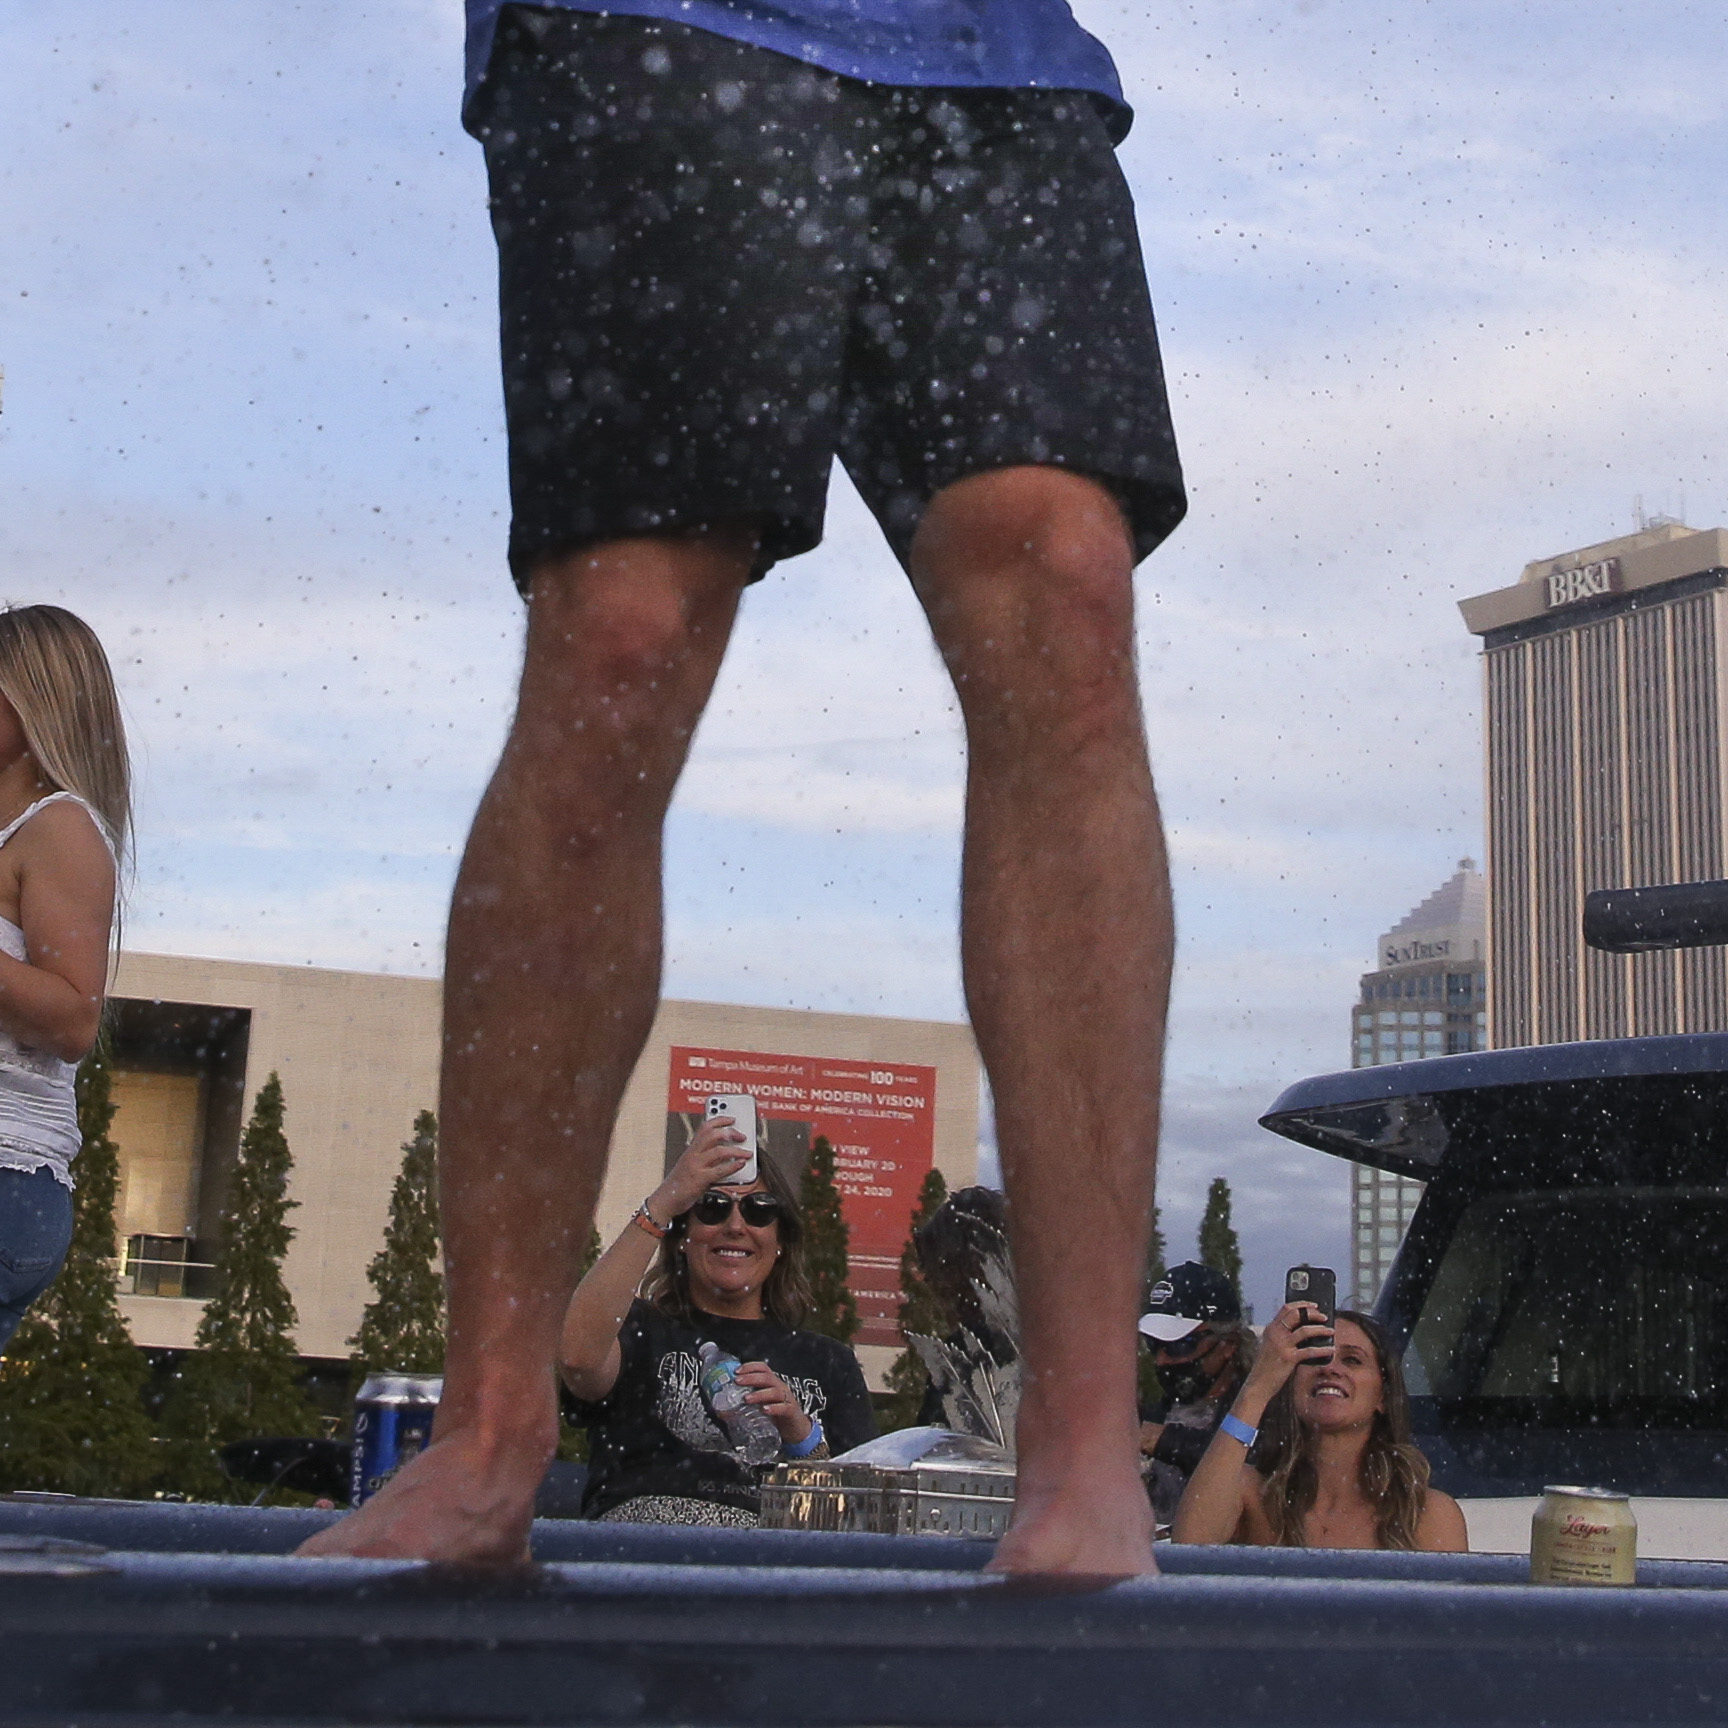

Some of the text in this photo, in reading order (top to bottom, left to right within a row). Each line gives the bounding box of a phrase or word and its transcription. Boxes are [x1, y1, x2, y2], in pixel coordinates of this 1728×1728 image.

[1548, 558, 1616, 608] BB&T
[870, 1071, 894, 1085] 100
[679, 1078, 925, 1109] MODERN WOMEN: MODERN VISION
[771, 1102, 797, 1112] BANK
[799, 1103, 812, 1113] OF
[814, 1104, 855, 1116] AMERICA
[858, 1108, 915, 1120] COLLECTION
[839, 1144, 871, 1156] VIEW
[863, 1185, 893, 1198] 2020
[352, 1438, 365, 1508] AMPSI
